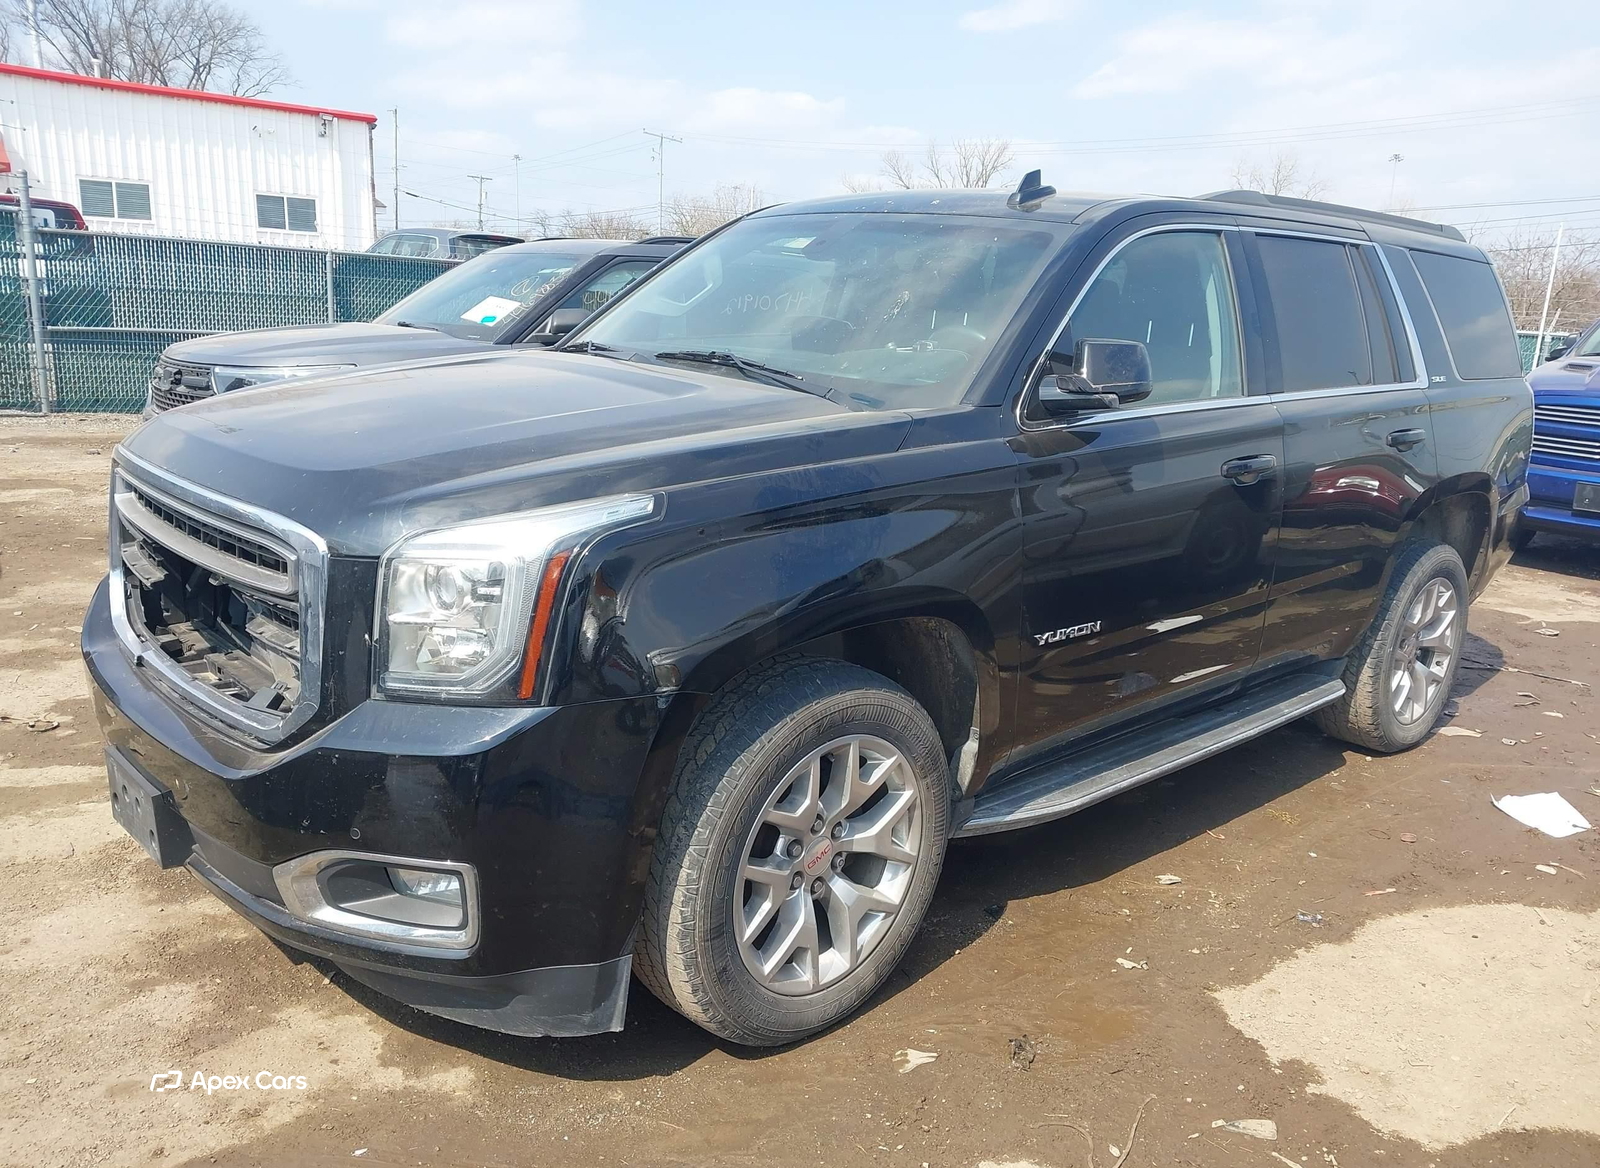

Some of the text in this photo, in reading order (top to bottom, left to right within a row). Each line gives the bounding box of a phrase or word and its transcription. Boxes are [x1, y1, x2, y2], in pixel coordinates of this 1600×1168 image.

[1033, 620, 1102, 646] YUKON
[715, 705, 867, 899] GOODYEAR
[807, 844, 831, 869] GMC
[818, 844, 943, 1023] WRANGLER
